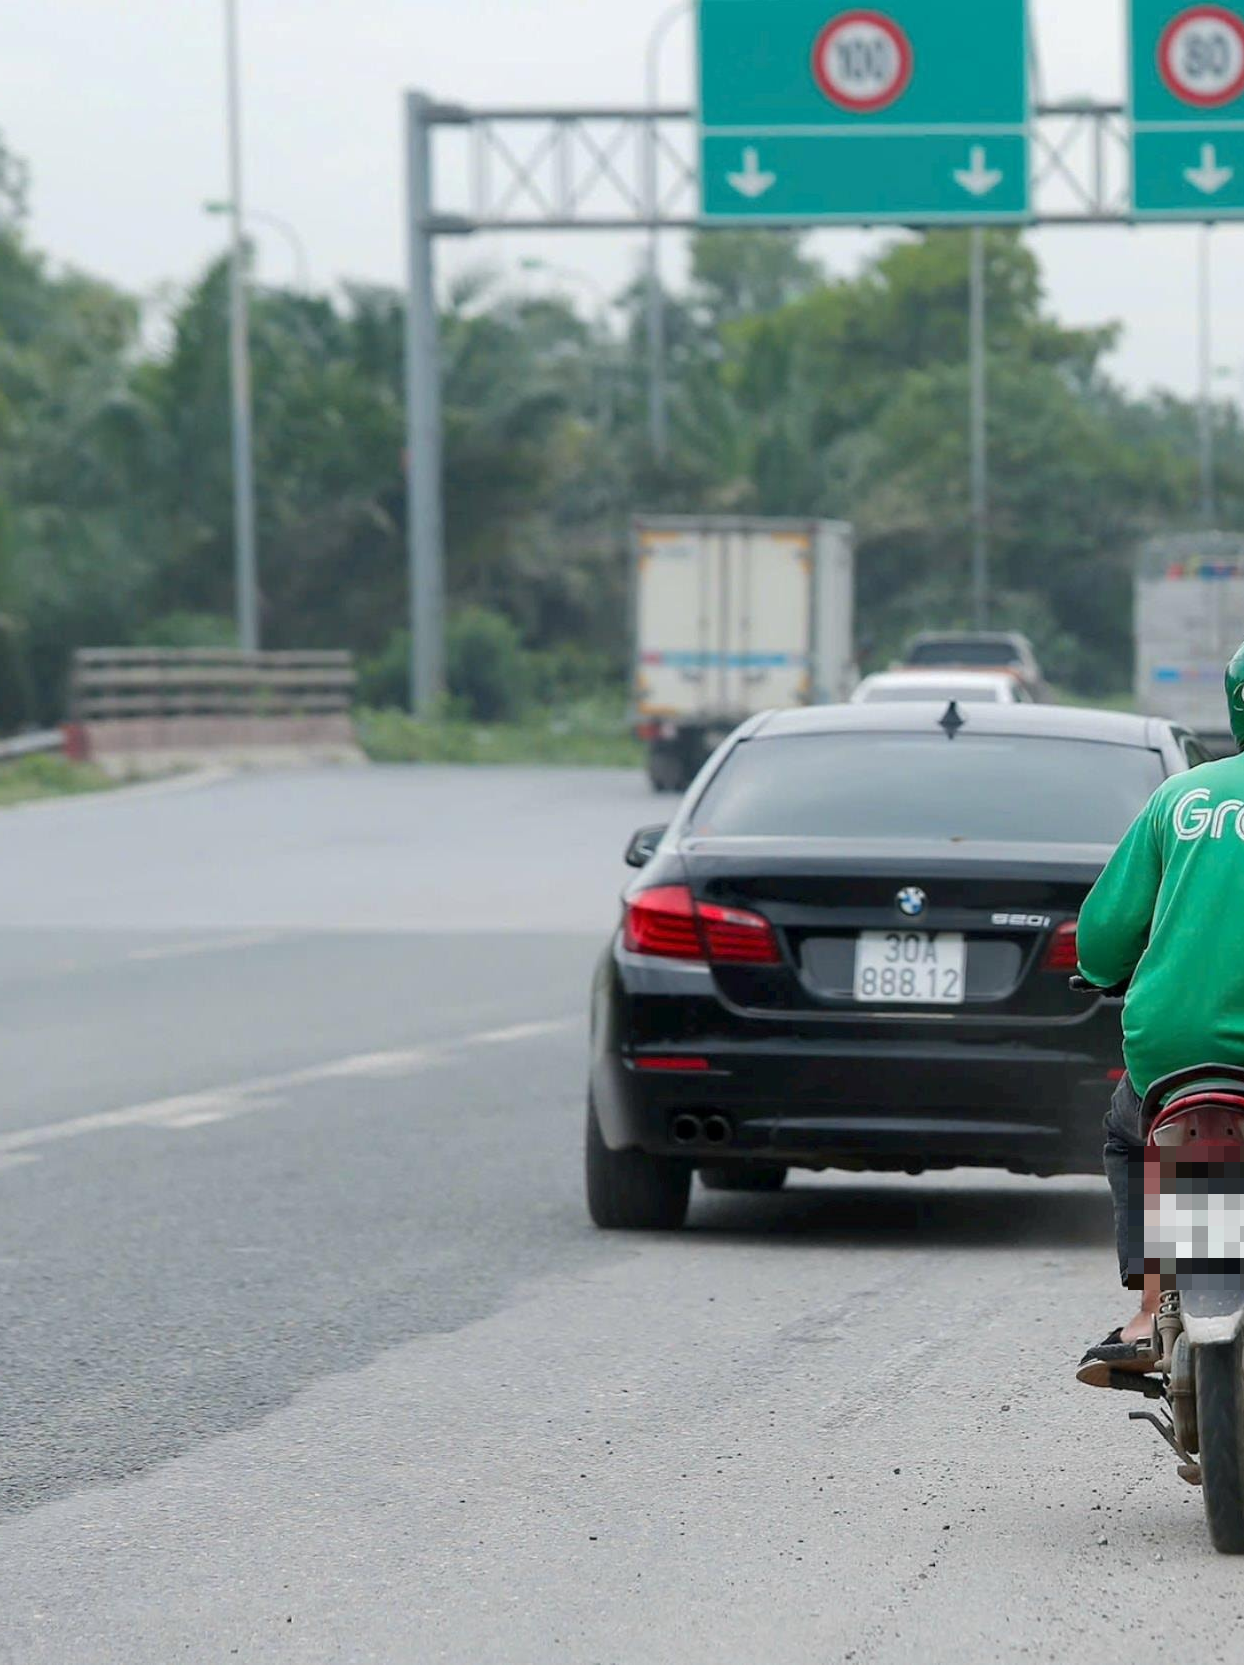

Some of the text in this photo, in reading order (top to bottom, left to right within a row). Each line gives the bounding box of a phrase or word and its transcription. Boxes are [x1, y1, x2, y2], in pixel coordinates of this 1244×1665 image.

[835, 41, 888, 80] 100
[1182, 38, 1230, 78] 80
[884, 934, 937, 963] 30A
[861, 967, 958, 998] 888.12
